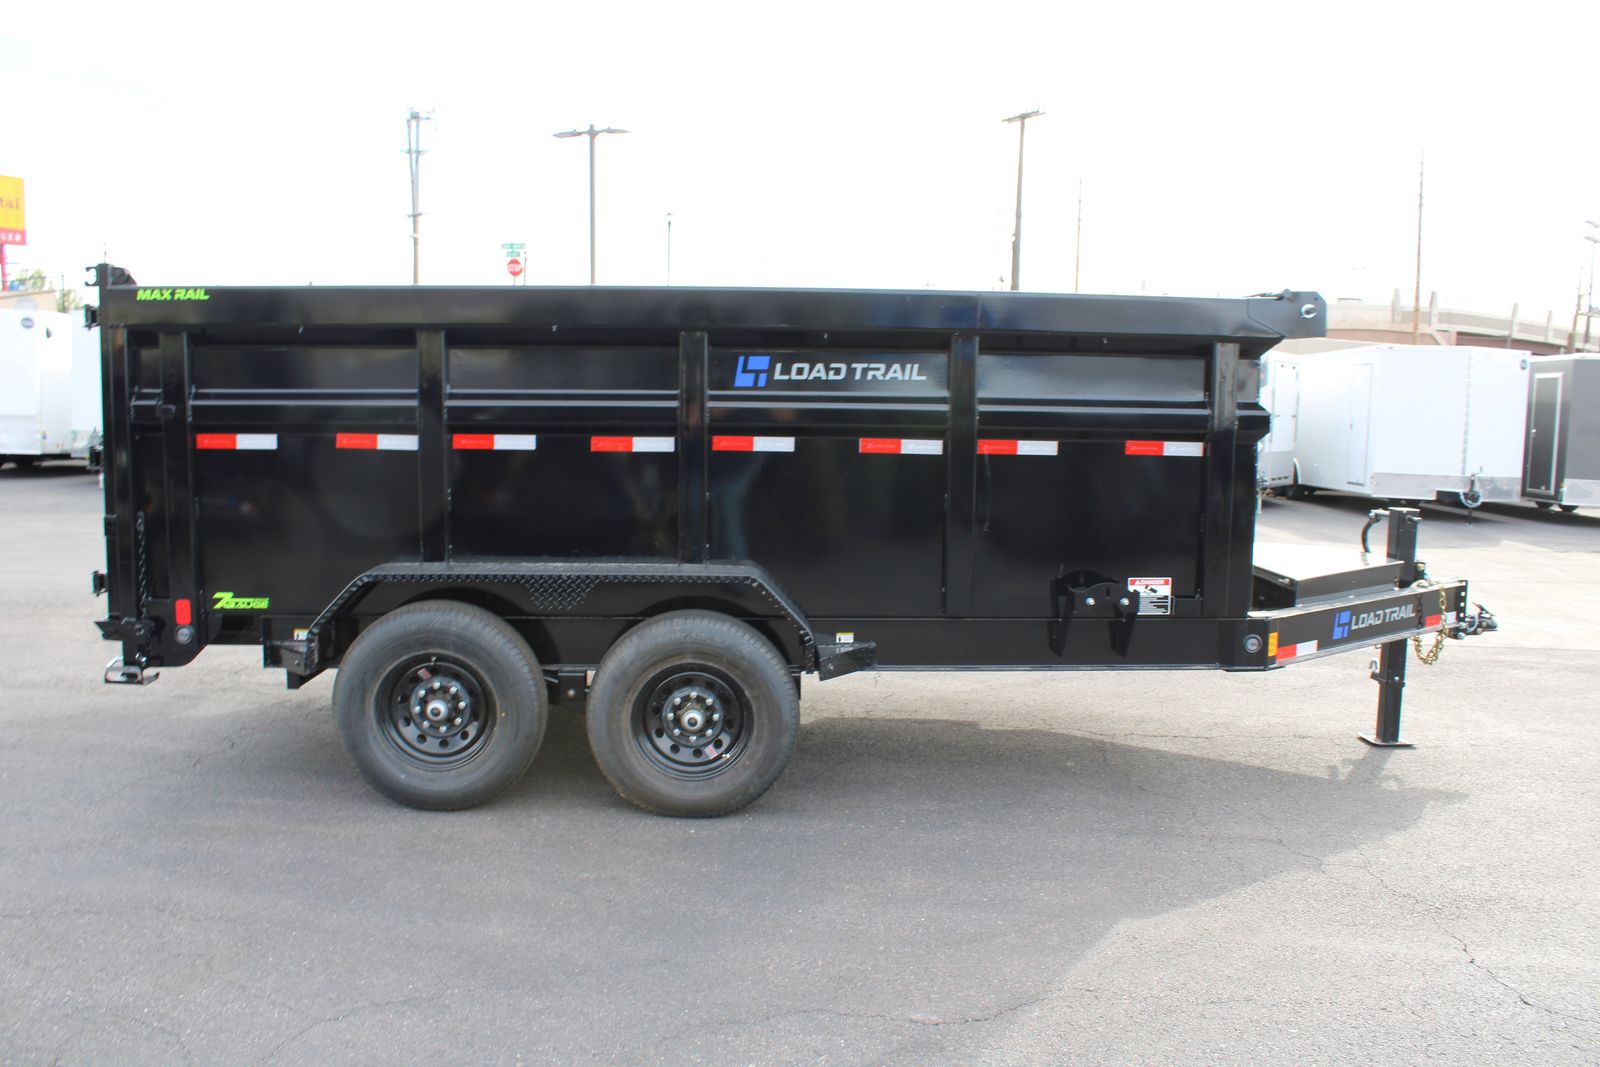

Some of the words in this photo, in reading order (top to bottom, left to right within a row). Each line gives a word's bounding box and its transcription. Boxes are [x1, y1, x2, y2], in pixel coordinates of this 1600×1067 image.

[136, 288, 173, 301] MAX
[174, 288, 210, 300] RAIL
[773, 362, 848, 381] LOAD
[850, 362, 928, 381] TRAIL
[1351, 610, 1384, 630] LOAD
[1384, 604, 1416, 623] TRAIL
